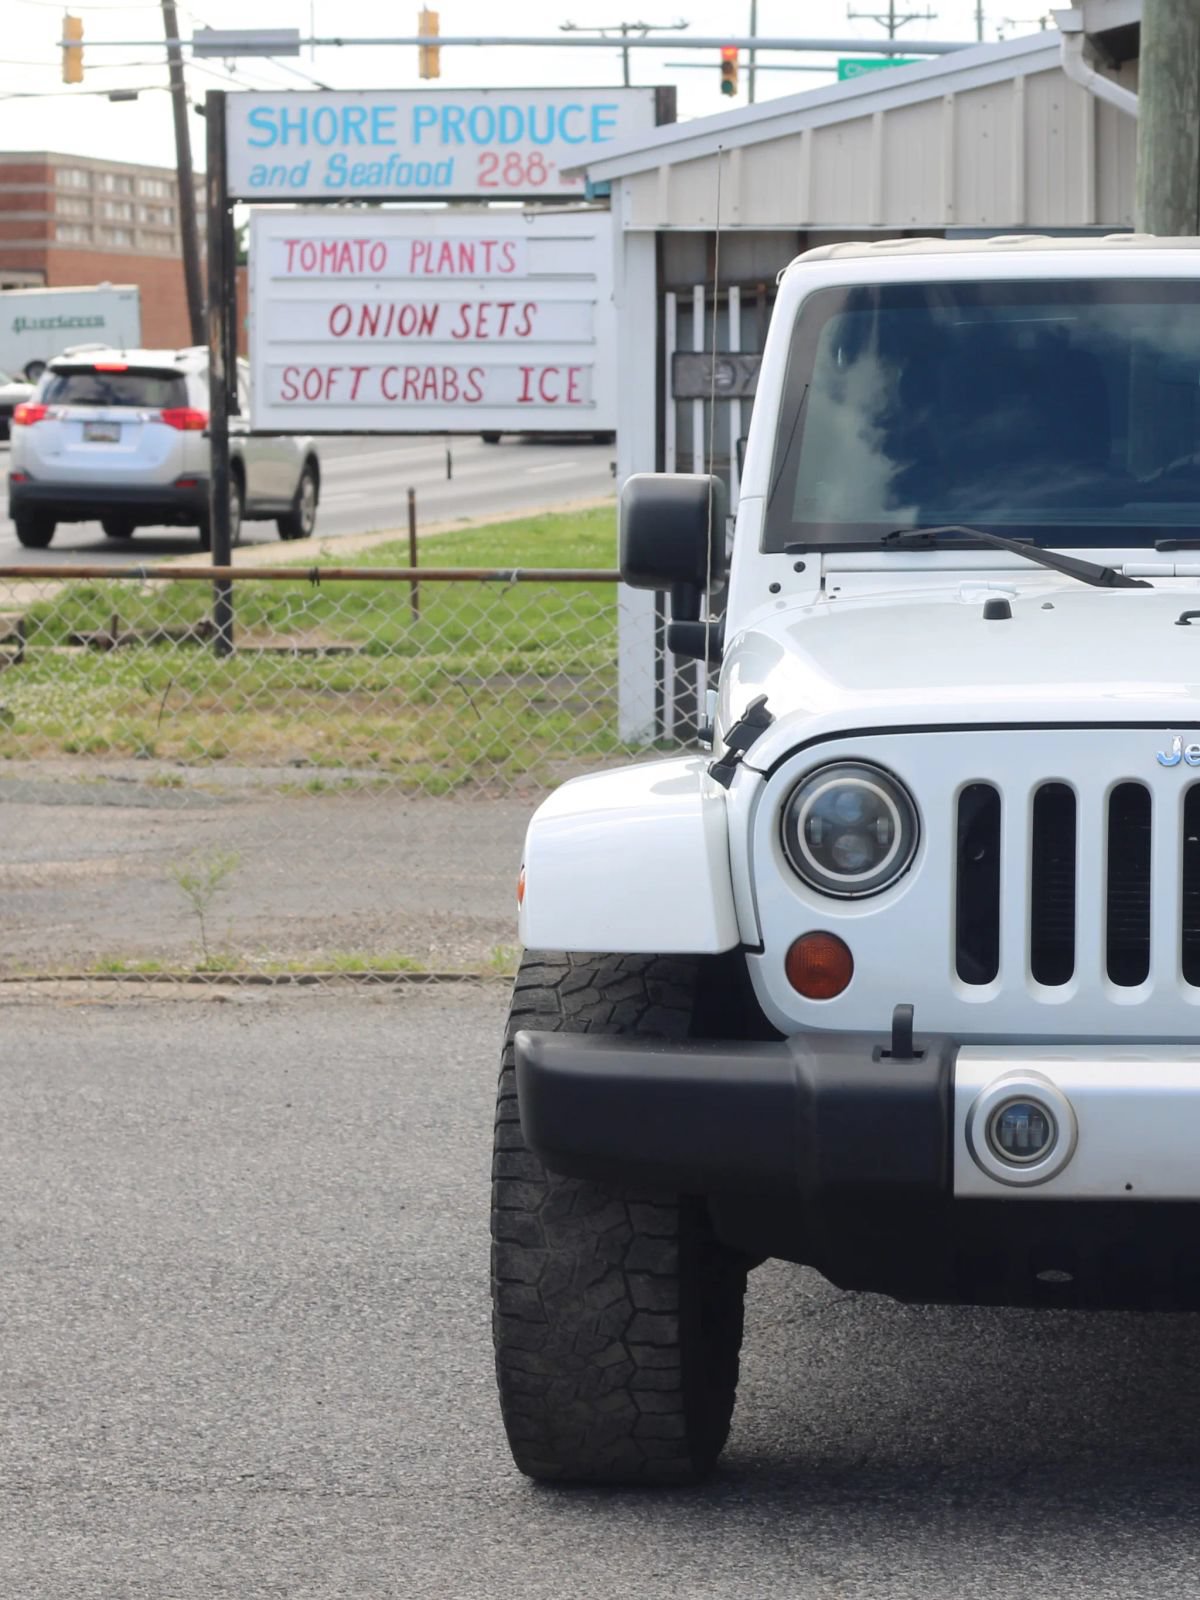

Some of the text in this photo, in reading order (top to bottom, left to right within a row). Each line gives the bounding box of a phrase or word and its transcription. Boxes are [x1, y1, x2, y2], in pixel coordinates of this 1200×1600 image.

[247, 103, 620, 148] SHORE PRODUCE
[248, 151, 584, 188] and Seafood 288-
[284, 239, 517, 275] TOMATO PLANTS
[329, 302, 538, 339] ONION SETS
[280, 365, 584, 404] SOFT CRABS ICE
